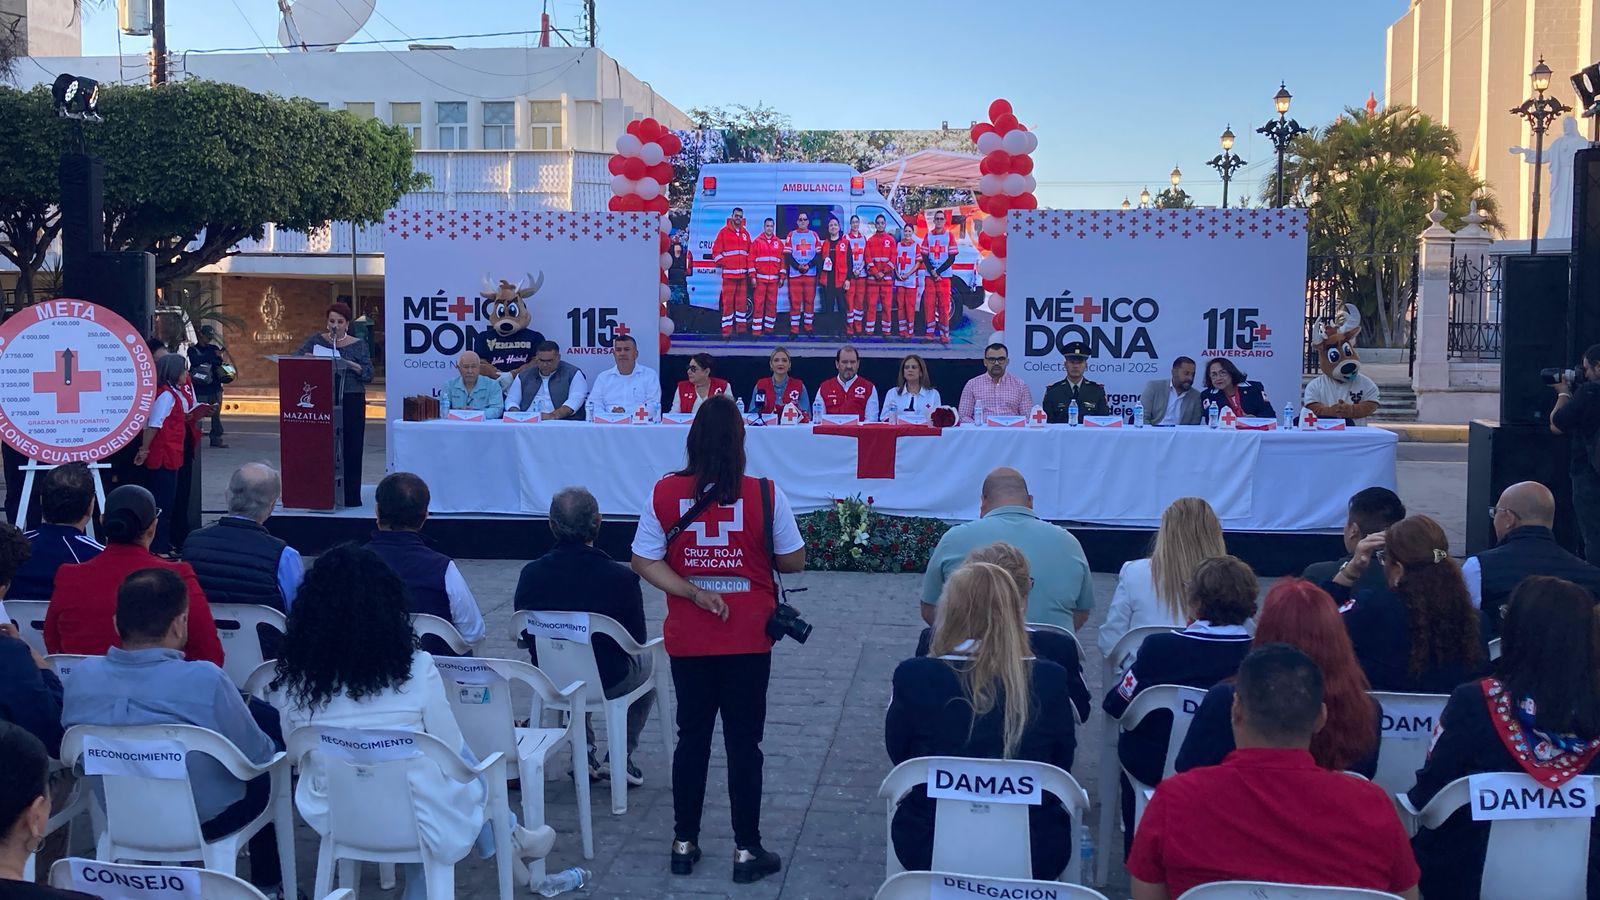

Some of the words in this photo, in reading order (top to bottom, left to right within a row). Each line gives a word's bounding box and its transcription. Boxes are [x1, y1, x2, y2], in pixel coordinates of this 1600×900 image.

[782, 183, 844, 192] AMBULANCIA
[699, 240, 713, 249] CRU
[35, 301, 95, 320] META
[1203, 308, 1259, 350] 115
[1024, 324, 1159, 359] DONA
[567, 347, 615, 355] ANIVERSA
[1201, 349, 1274, 358] ANIVERSARIO
[133, 344, 153, 386] PESOS
[403, 358, 446, 369] Colecta
[1128, 363, 1158, 373] 2025
[139, 390, 153, 412] MIL
[283, 411, 331, 421] MAZATLÁN
[42, 413, 145, 462] CUATROCIENTOS
[684, 547, 710, 557] CRUZ
[714, 548, 743, 557] ROJA
[684, 558, 743, 568] MEXICANA
[527, 619, 587, 633] RECONOCIMIENTO
[1381, 714, 1432, 732] DAM
[320, 734, 413, 750] RECONOCIMIENTO
[88, 747, 182, 763] RECONOCIMIENTO
[935, 769, 1034, 795] DAMAS
[1479, 786, 1587, 811] DAMAS
[82, 866, 184, 891] CONSEJO
[944, 875, 1057, 900] DELEGACIÓN
